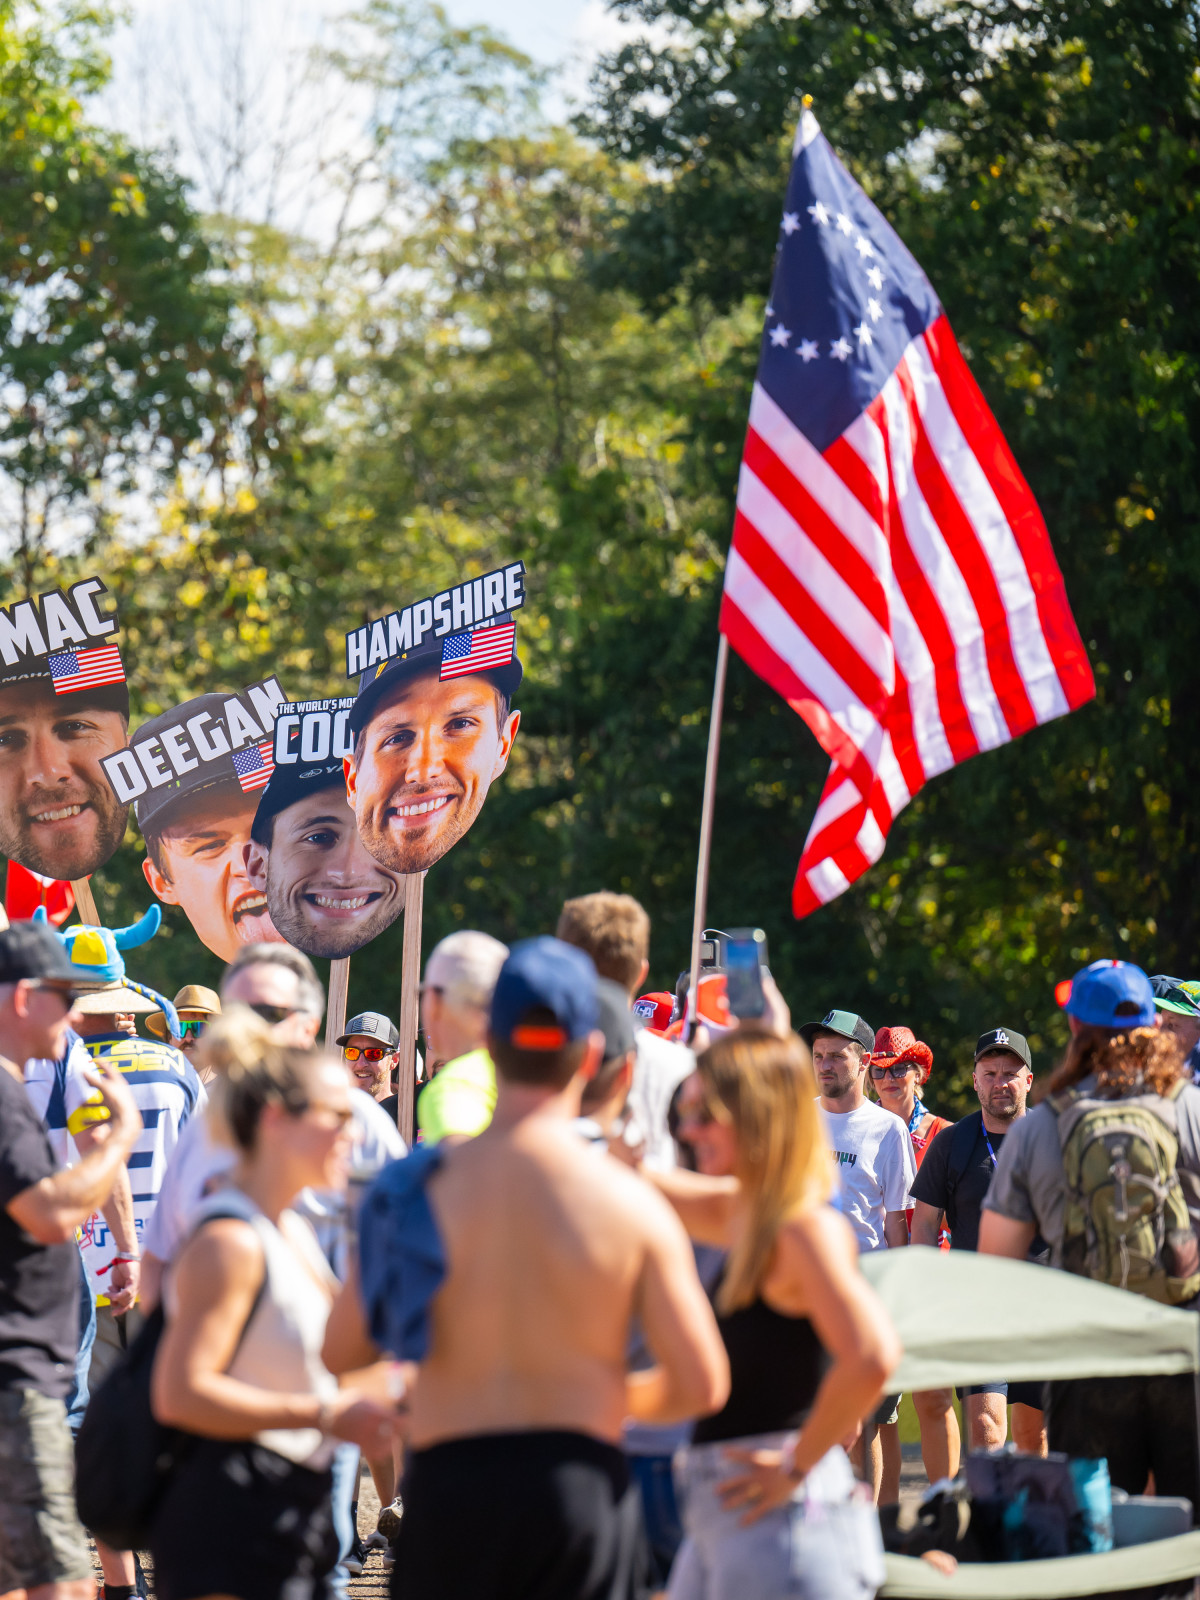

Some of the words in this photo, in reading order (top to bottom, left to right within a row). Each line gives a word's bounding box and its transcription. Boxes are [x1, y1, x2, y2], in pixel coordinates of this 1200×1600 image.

[347, 564, 523, 675] HAMPSHIRE
[103, 678, 286, 804] DEEGAN
[279, 703, 296, 714] THE
[296, 699, 337, 713] WORLD'S
